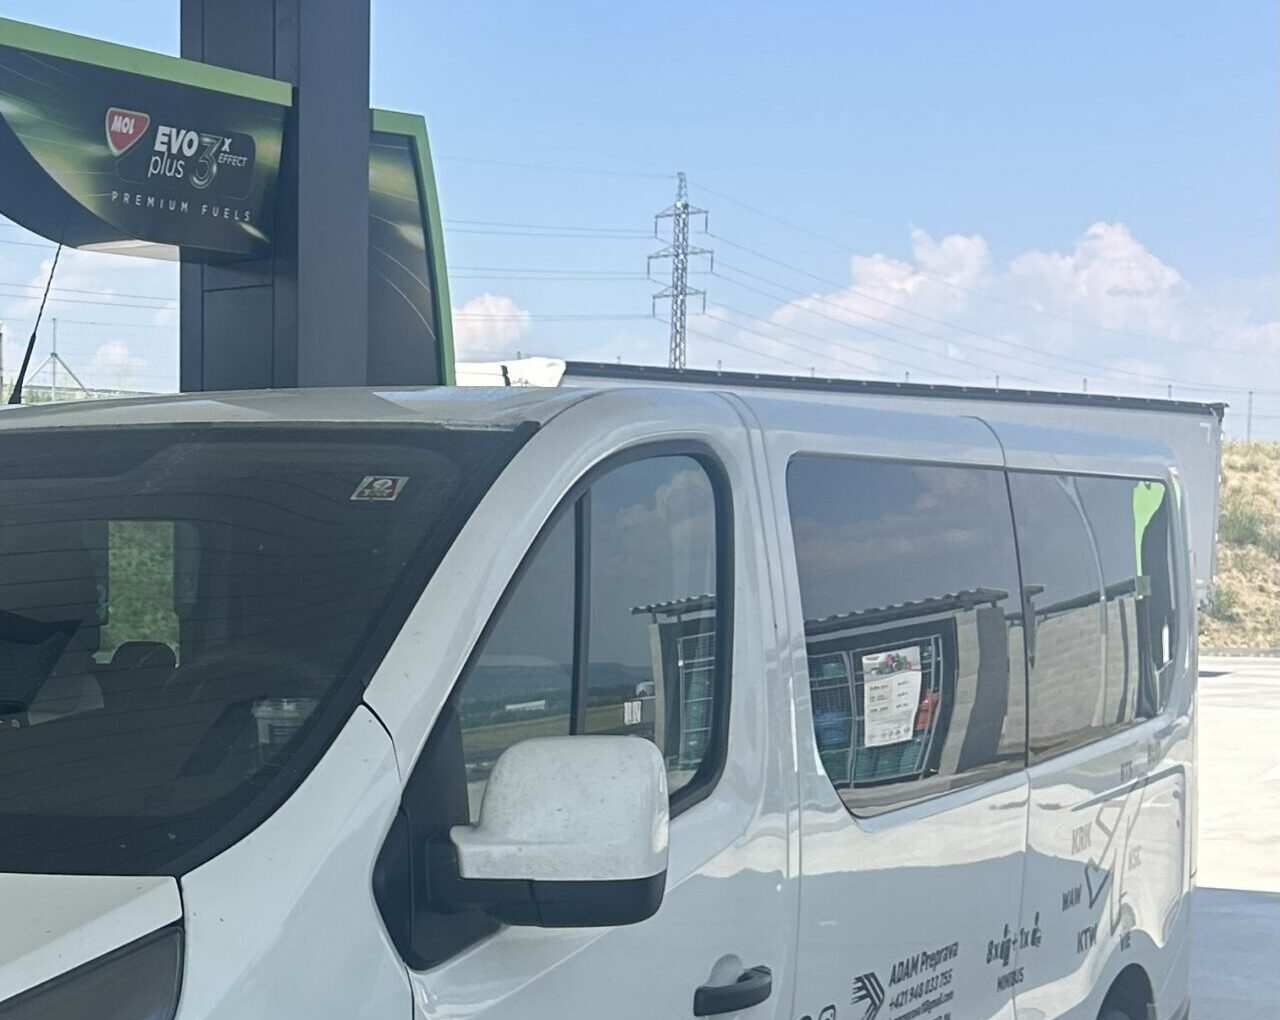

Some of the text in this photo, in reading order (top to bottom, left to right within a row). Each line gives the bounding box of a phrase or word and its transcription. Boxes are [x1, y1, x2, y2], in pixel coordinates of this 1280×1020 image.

[111, 115, 136, 135] MOL
[153, 125, 199, 157] EVO
[147, 152, 185, 178] plus
[189, 132, 223, 189] 3
[218, 153, 248, 167] EFFECT
[111, 191, 251, 222] PREMIUM FUELS
[888, 941, 959, 988] ADAM Preprava
